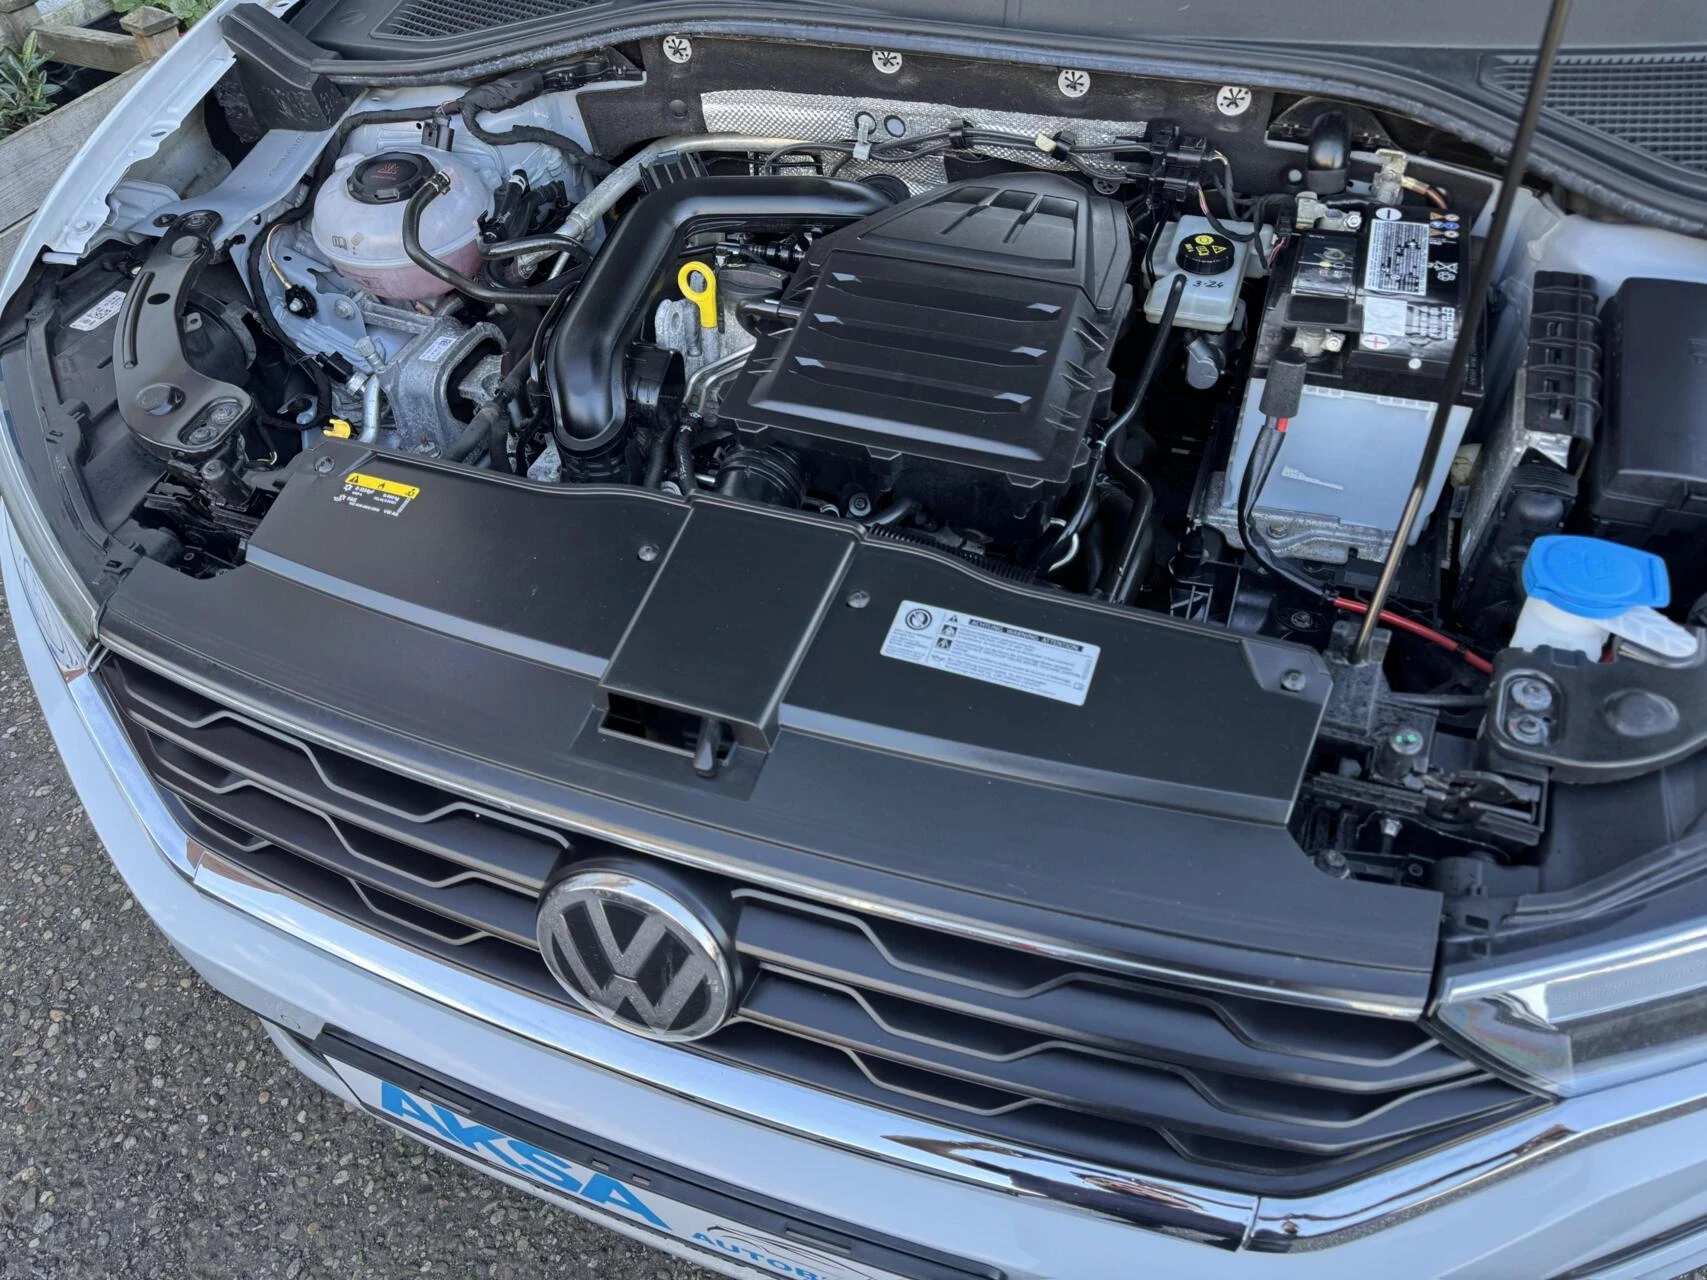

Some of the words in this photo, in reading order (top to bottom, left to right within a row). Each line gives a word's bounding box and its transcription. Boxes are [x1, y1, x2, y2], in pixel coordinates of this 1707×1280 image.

[970, 619, 1003, 632] ACHTUNG
[1005, 627, 1040, 642] WARNING
[1041, 636, 1080, 651] ATTENTION
[381, 1080, 672, 1230] AKSA
[692, 1232, 827, 1280] AUTOB
